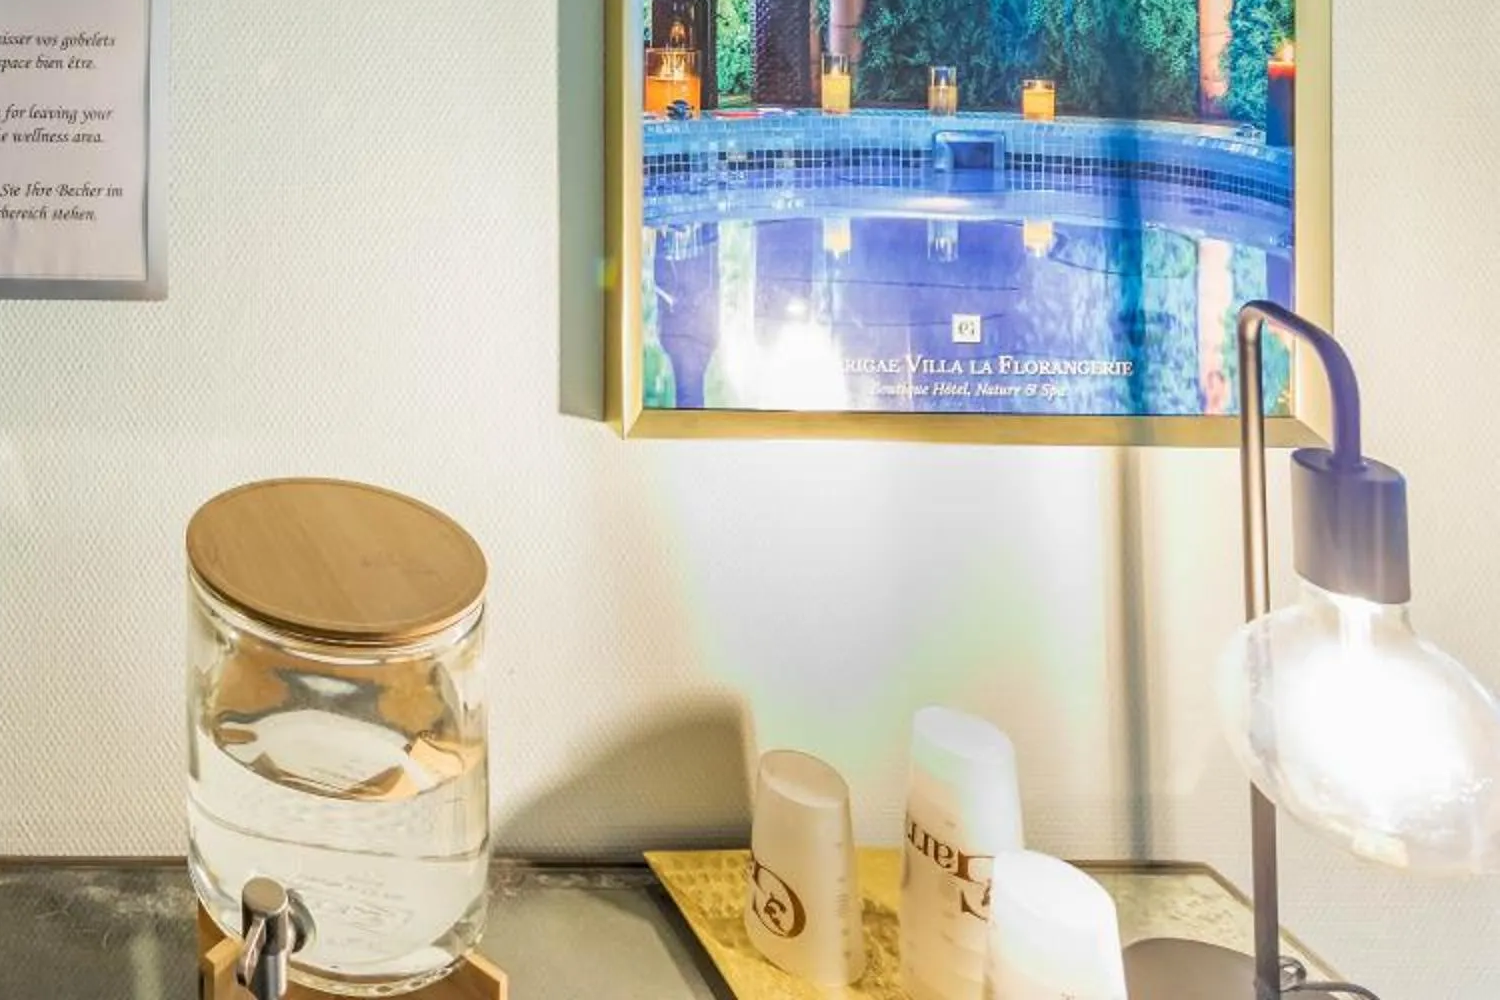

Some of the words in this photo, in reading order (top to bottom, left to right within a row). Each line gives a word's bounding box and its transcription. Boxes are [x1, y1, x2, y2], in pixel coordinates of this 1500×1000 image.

[35, 34, 57, 46] vos
[61, 32, 116, 50] gobelets
[35, 55, 63, 69] bien
[1, 104, 26, 123] for
[29, 104, 77, 124] leaving
[80, 107, 114, 125] your
[13, 127, 69, 143] wellness
[71, 130, 104, 143] area.
[0, 183, 20, 197] Sie
[25, 183, 52, 198] Ihre
[55, 182, 102, 197] Becher
[106, 184, 123, 197] im
[51, 205, 96, 220] stehen.
[840, 359, 900, 375] RIGAE
[906, 355, 962, 374] VILLA
[970, 360, 993, 374] LA
[976, 382, 1022, 397] Nature
[1026, 382, 1038, 396] &
[1041, 382, 1066, 399] Spa
